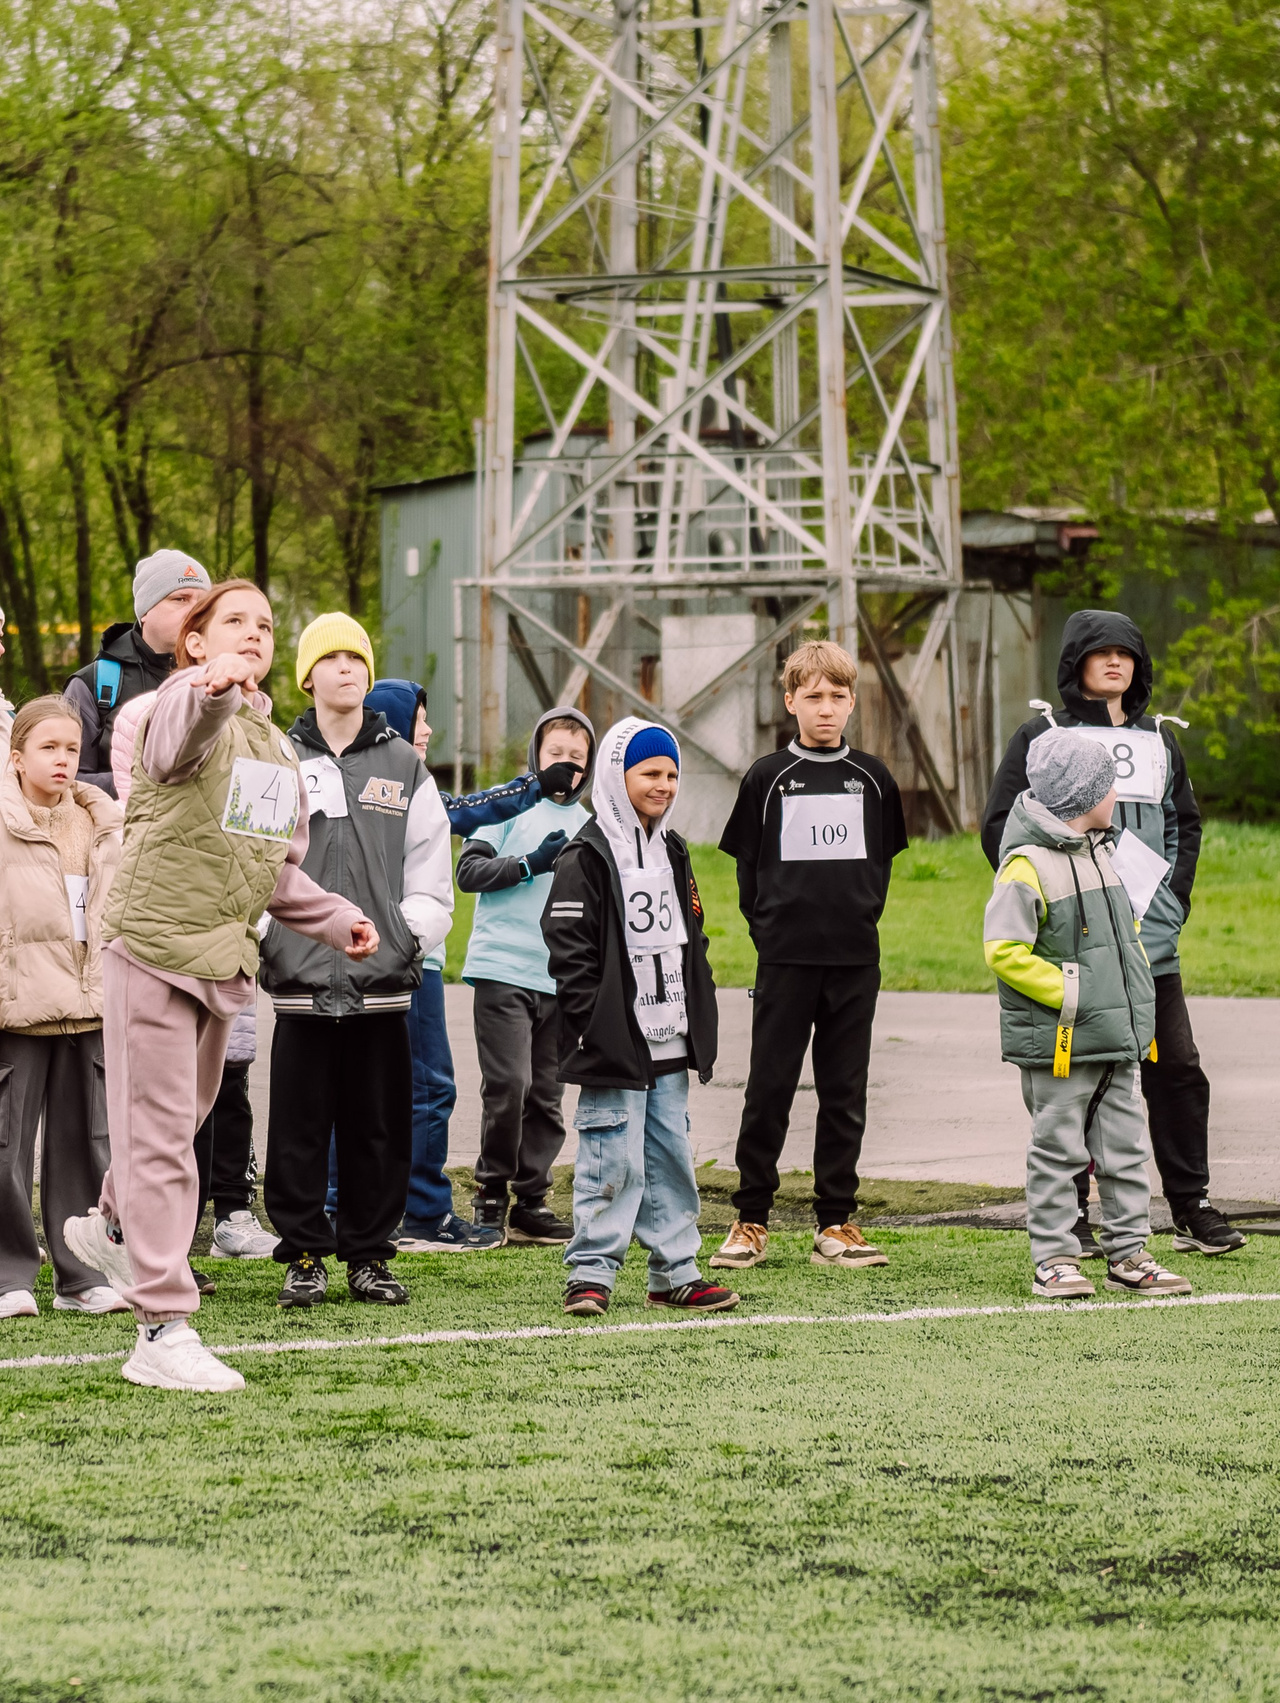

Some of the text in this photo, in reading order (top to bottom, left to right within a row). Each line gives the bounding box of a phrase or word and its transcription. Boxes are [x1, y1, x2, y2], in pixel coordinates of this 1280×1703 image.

[261, 769, 281, 821] 4
[359, 777, 409, 810] ACL
[810, 823, 848, 846] 109
[628, 889, 672, 934] 35
[645, 1025, 676, 1040] Angels
